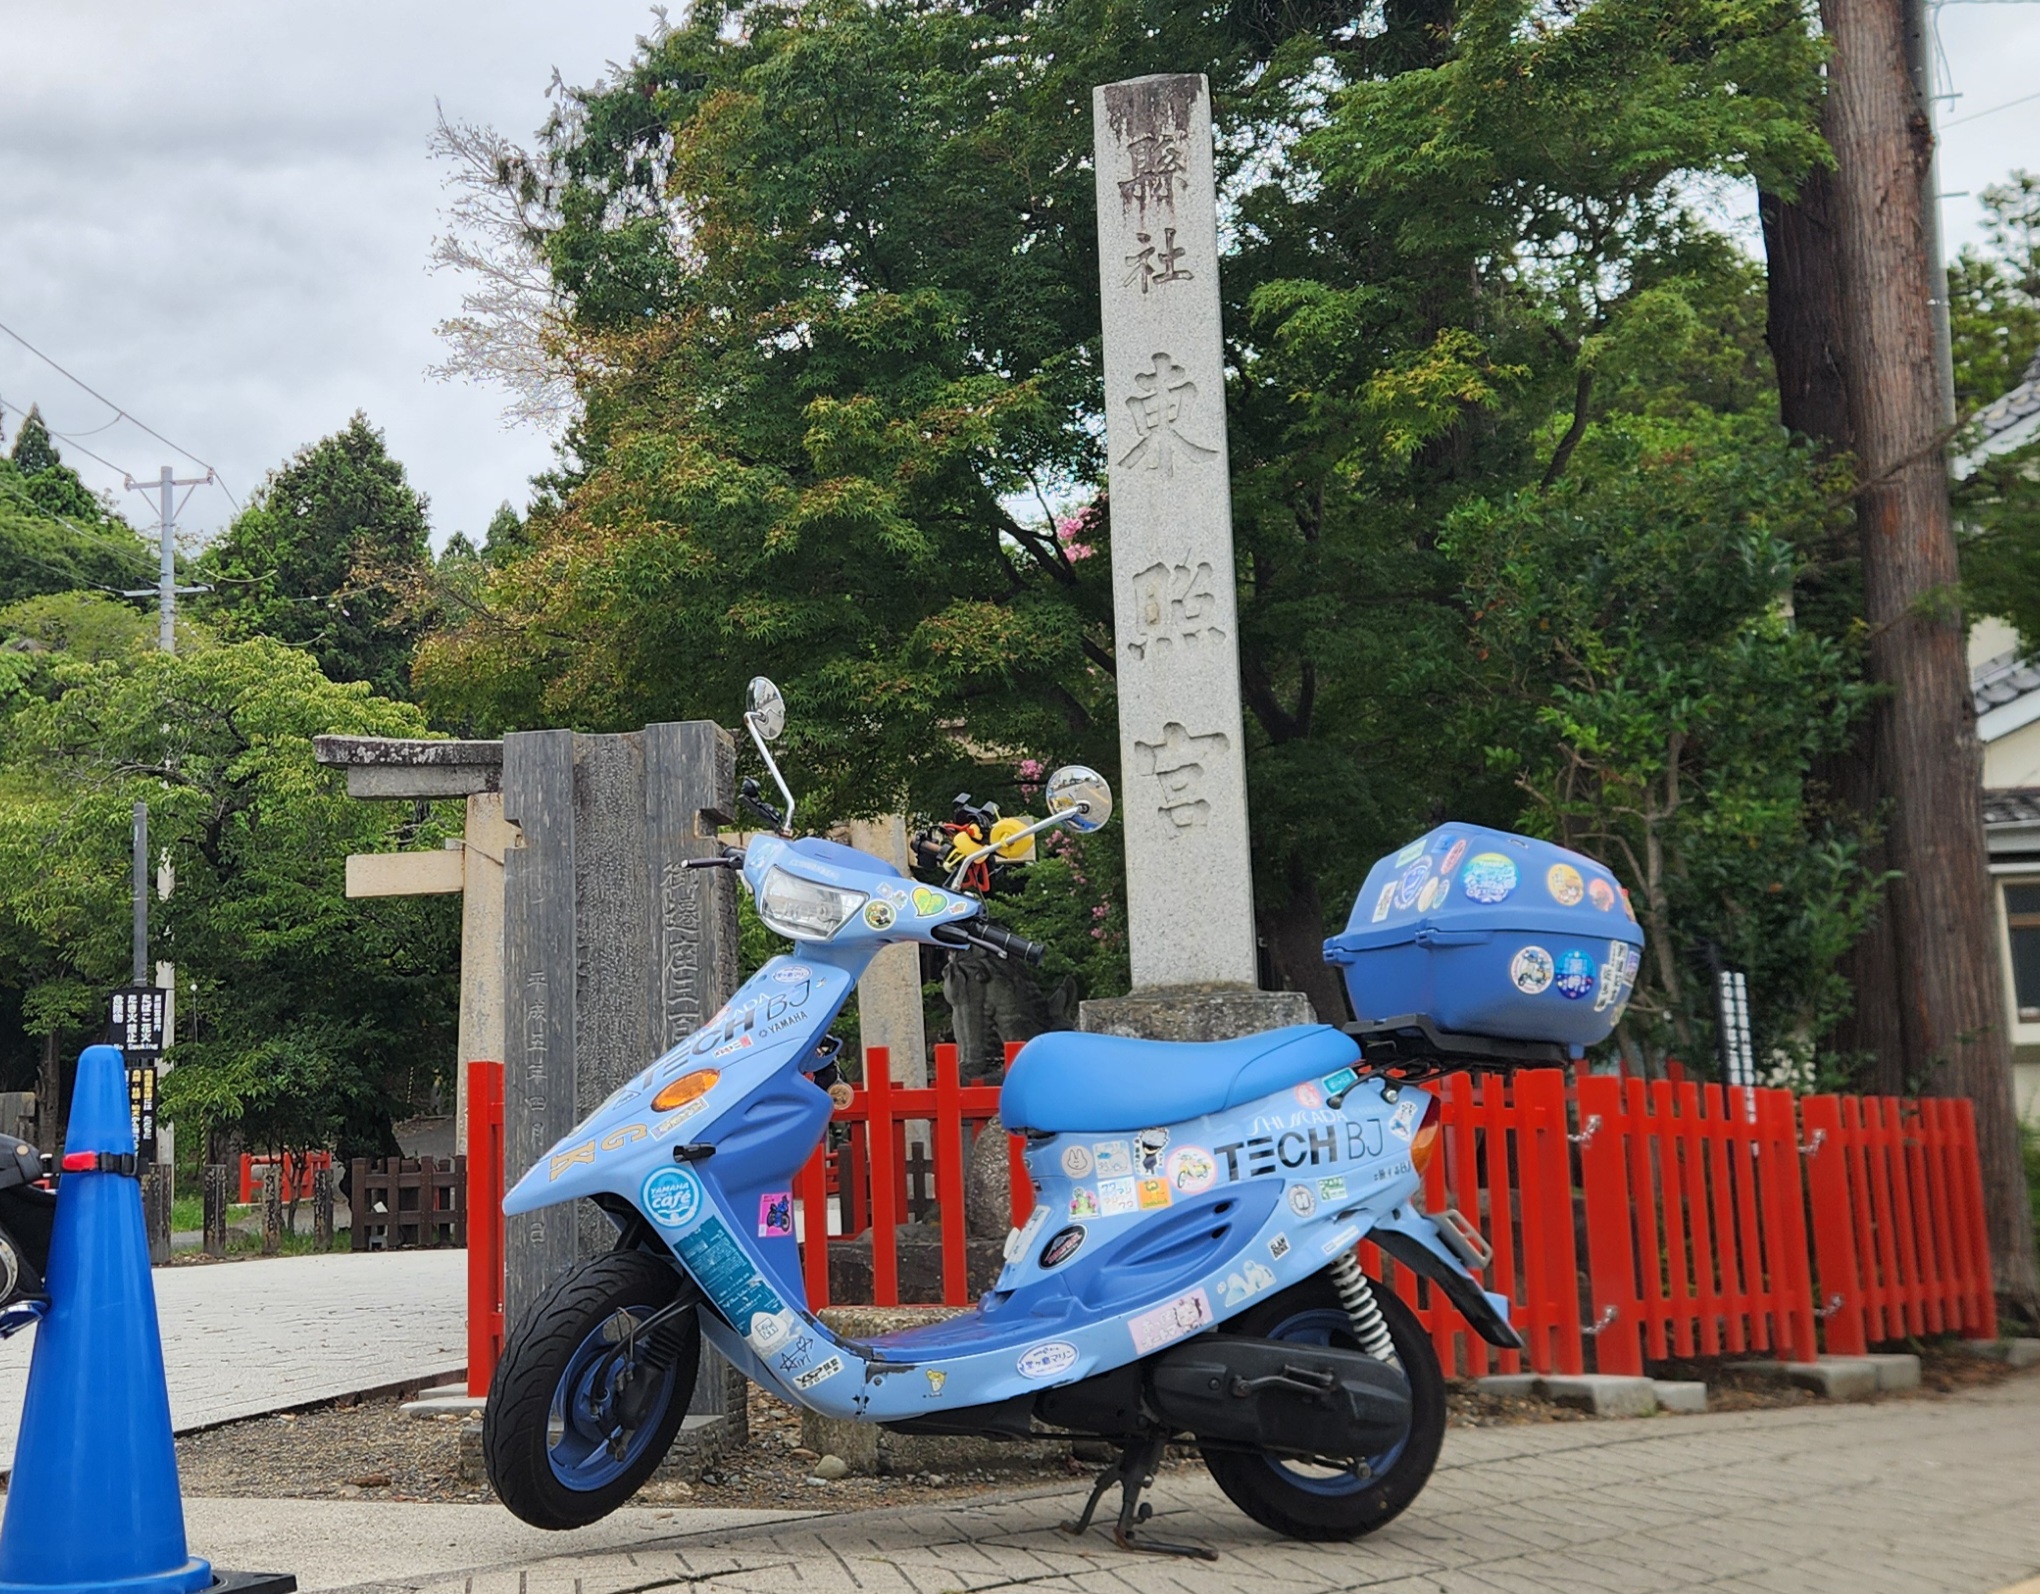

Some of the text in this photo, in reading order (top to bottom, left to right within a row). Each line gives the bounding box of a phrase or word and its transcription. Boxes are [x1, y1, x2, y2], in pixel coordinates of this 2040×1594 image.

[766, 979, 811, 1022] BJ
[768, 1010, 808, 1035] YAMAHA
[641, 1008, 755, 1090] TECH
[1214, 1125, 1338, 1181] TECH
[1346, 1118, 1384, 1160] BJ
[650, 1181, 689, 1195] YAMAHA
[652, 1189, 692, 1209] café
